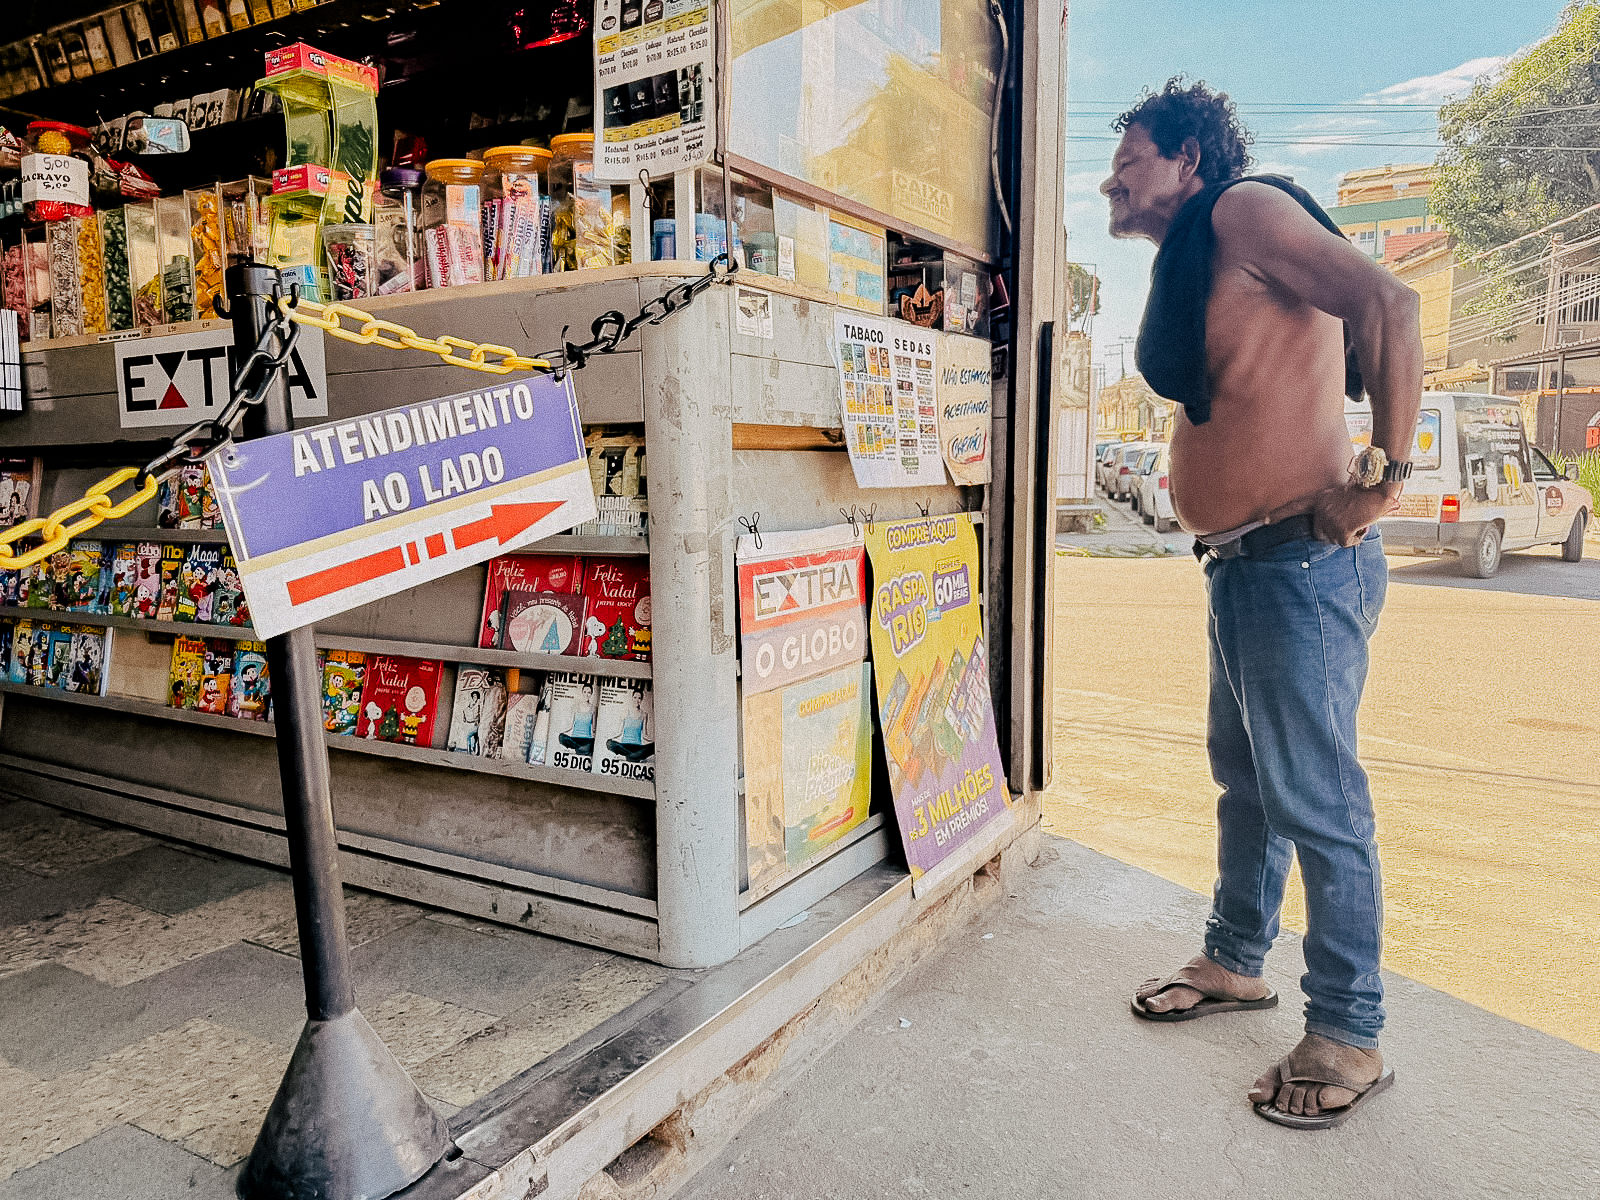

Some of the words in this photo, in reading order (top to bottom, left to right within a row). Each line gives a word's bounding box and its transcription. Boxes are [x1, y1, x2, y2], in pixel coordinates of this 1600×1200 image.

[538, 203, 550, 257] mentos
[844, 324, 884, 344] TABACO
[894, 338, 931, 356] SEDAS
[123, 345, 318, 412] EXTA
[960, 367, 990, 385] ESTAMOS
[943, 400, 988, 420] ACEITANDO
[292, 384, 535, 478] ATENDIMENTO
[362, 472, 411, 521] AO
[418, 446, 506, 502] LADO
[887, 523, 929, 550] COMPRE
[495, 560, 526, 578] Feliz
[592, 564, 624, 582] Feliz
[504, 577, 540, 592] Natal
[597, 582, 638, 599] Natal
[755, 562, 856, 618] EXTRA
[935, 576, 953, 606] 60
[952, 572, 968, 593] MIL
[878, 575, 928, 618] RASPA
[756, 642, 775, 678] O
[782, 619, 858, 670] GLOBO
[372, 656, 398, 673] Feliz
[377, 671, 410, 688] Natal
[461, 668, 490, 690] TEX
[554, 752, 569, 768] 95
[601, 757, 620, 776] 95
[620, 761, 654, 781] DICAS
[914, 806, 928, 838] 3
[927, 762, 994, 829] MILHÕES
[934, 824, 952, 848] EM
[949, 796, 990, 837] PRÊMIOS!
